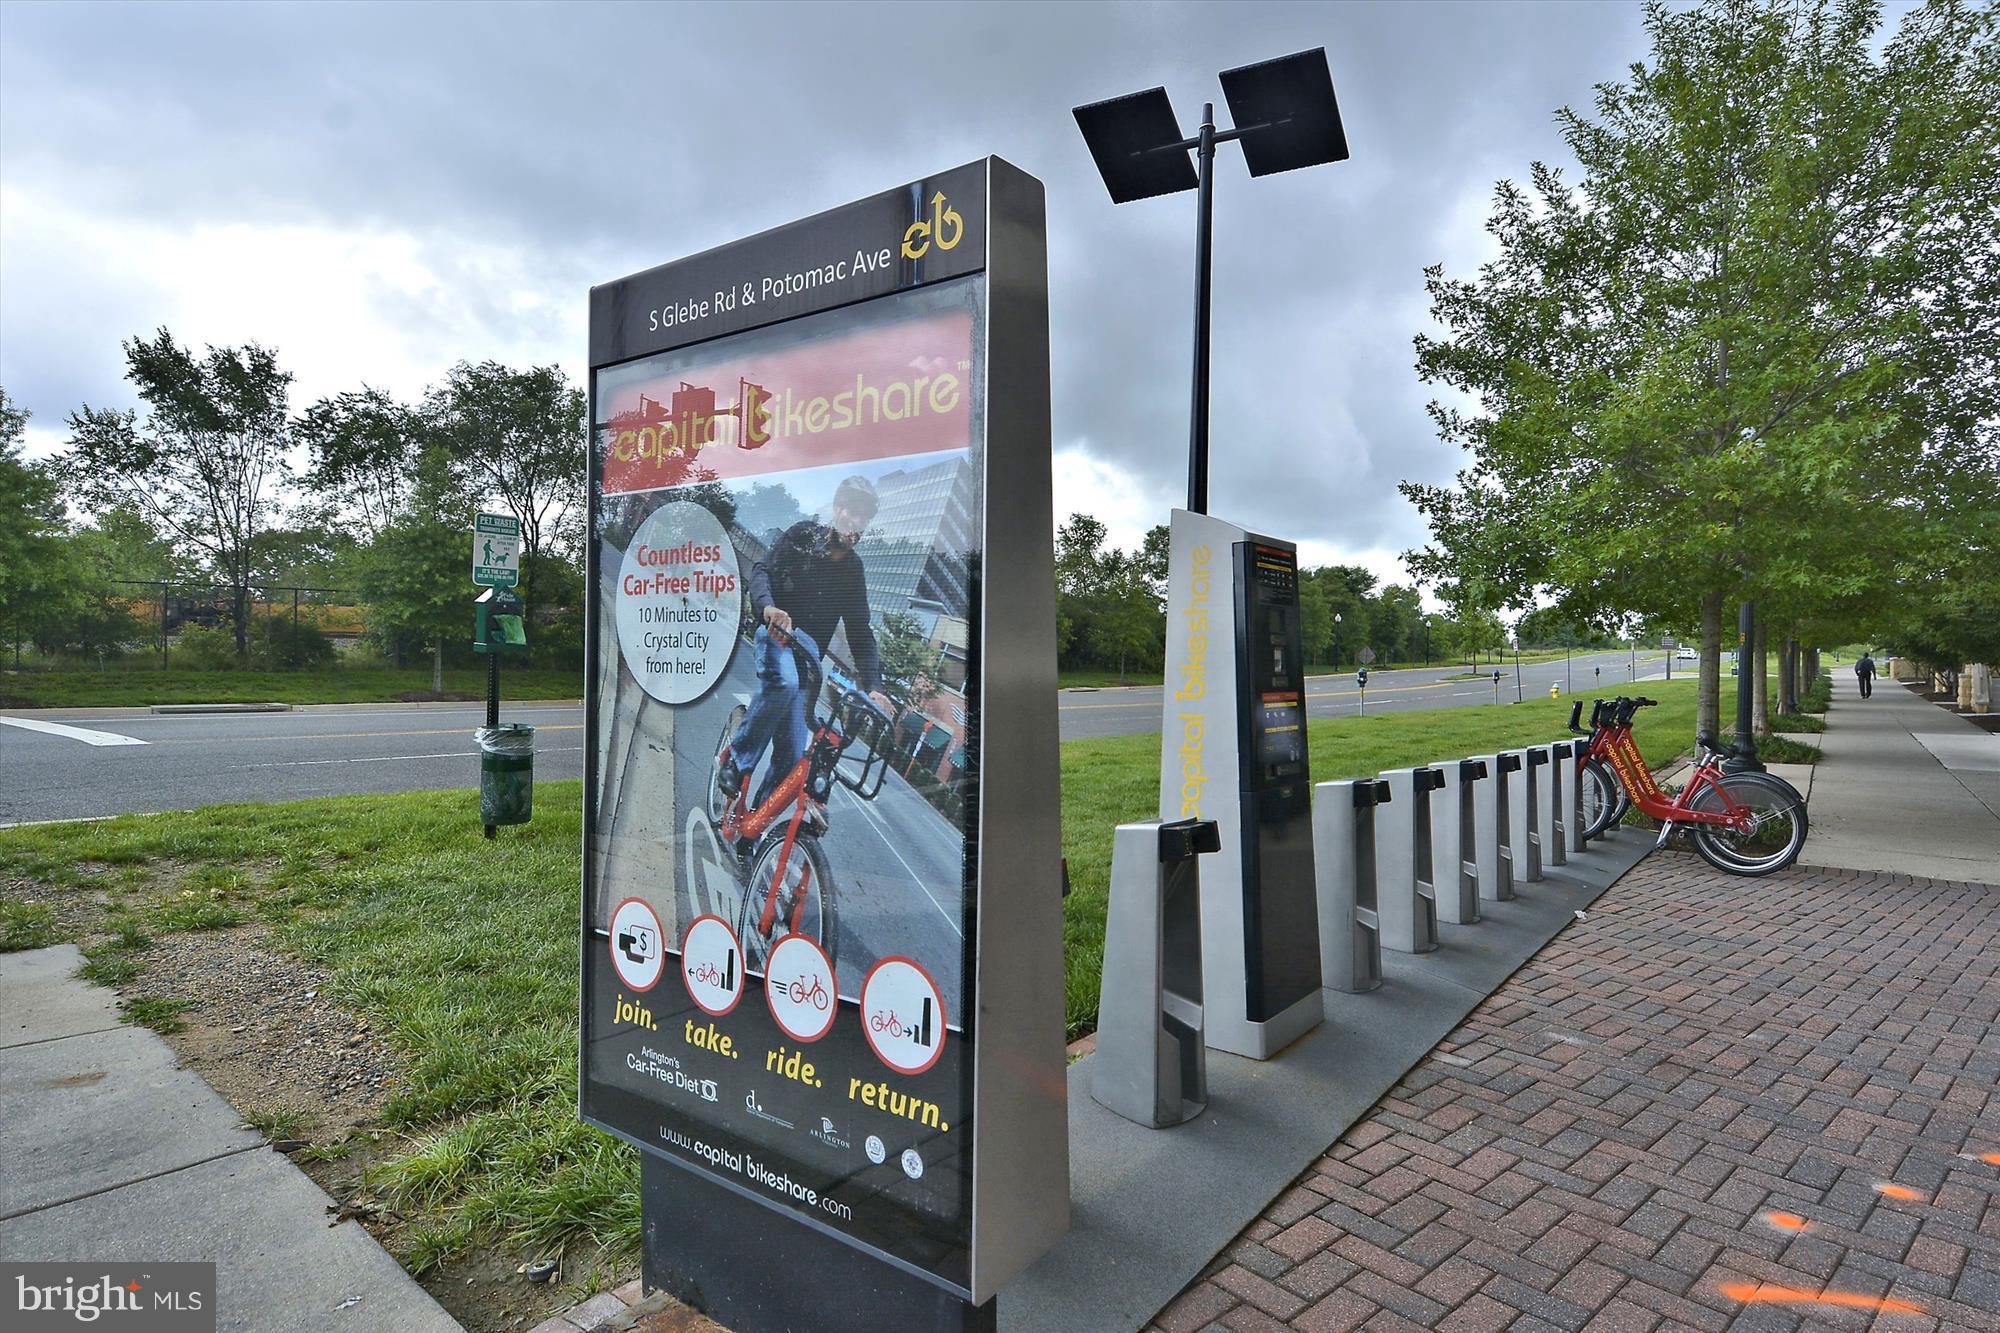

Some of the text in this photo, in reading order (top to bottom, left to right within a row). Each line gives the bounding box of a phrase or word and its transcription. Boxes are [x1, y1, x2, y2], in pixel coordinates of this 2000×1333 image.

[649, 248, 891, 332] S Glebe Rd & Potomac Ave
[614, 396, 735, 469] capital
[747, 371, 960, 443] bikeshare
[494, 518, 517, 527] WASTE
[637, 540, 721, 567] Countless
[623, 569, 736, 598] Car-Free Trips
[639, 607, 717, 623] 10 Minutes to
[644, 631, 709, 652] Crystal City
[646, 657, 706, 675] from here!
[1175, 543, 1212, 821] capital bikeshare
[1606, 743, 1625, 769] capital
[1623, 738, 1641, 762] capital
[614, 994, 658, 1032] join.
[685, 1019, 738, 1059] take.
[641, 1045, 681, 1069] Arlington's
[765, 1046, 822, 1089] ride.
[626, 1052, 700, 1095] Car-Free Diet
[848, 1076, 950, 1132] return.
[659, 1124, 742, 1174] www.capital
[809, 1128, 851, 1149] ARLINGTON
